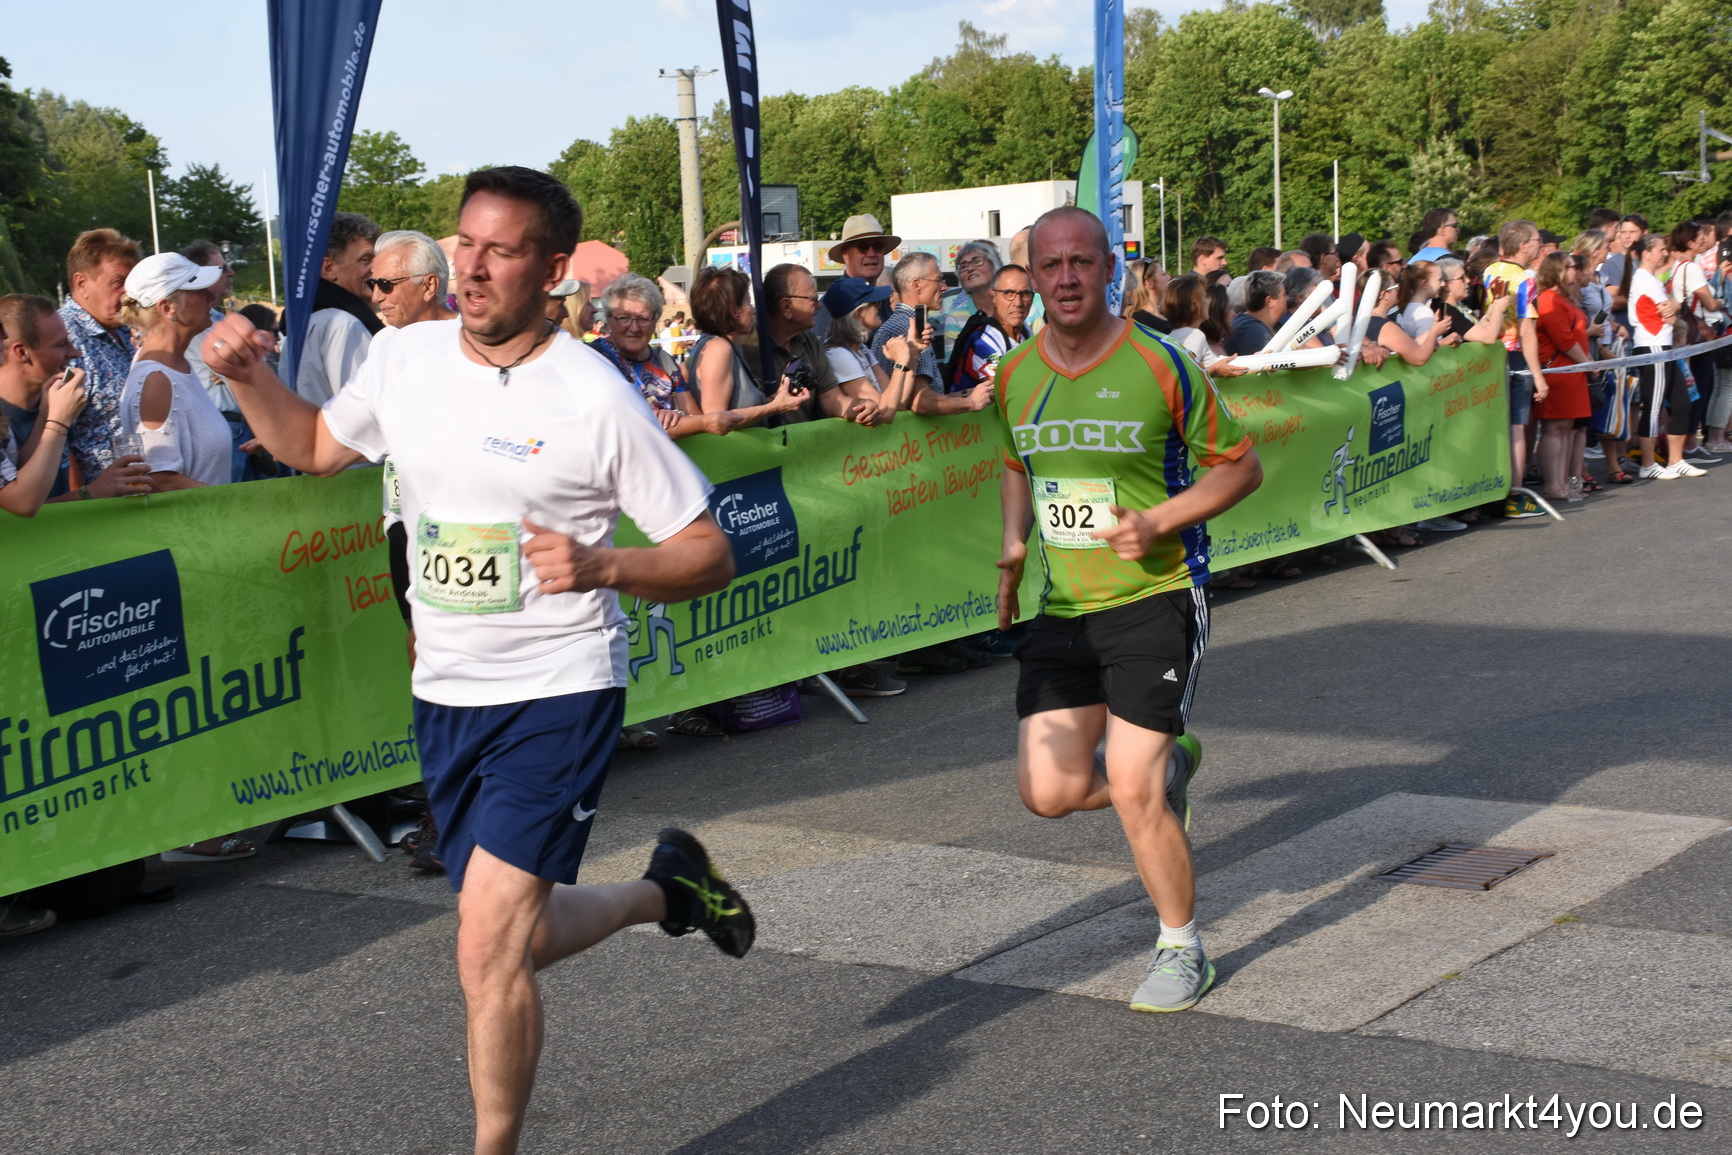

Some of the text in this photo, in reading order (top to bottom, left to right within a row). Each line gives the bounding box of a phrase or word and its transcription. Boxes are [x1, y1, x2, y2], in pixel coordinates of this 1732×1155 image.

[1377, 403, 1401, 420] Fischer
[842, 423, 984, 487] Gesunde Firmen
[1012, 418, 1147, 456] BOCK
[1353, 423, 1434, 491] firmenlauf
[886, 445, 1002, 517] laufen länger!
[728, 501, 779, 528] Fischer
[739, 517, 781, 537] AUTOMOBILE
[1048, 503, 1095, 529] 302
[280, 514, 387, 574] Gesun
[422, 548, 502, 587] 2034
[345, 572, 394, 613] lau
[66, 598, 162, 640] Fischer
[77, 620, 156, 652] AUTOMOBILE
[815, 590, 1000, 656] www.firmenlauf-oberpfalz.
[118, 650, 138, 664] das
[139, 636, 179, 658] Lächeln
[695, 617, 773, 664] neumarkt
[124, 648, 177, 683] fährt mit!
[0, 625, 305, 803] firmenlauf
[231, 724, 418, 805] www.firmenlauf
[4, 758, 151, 834] neumarkt
